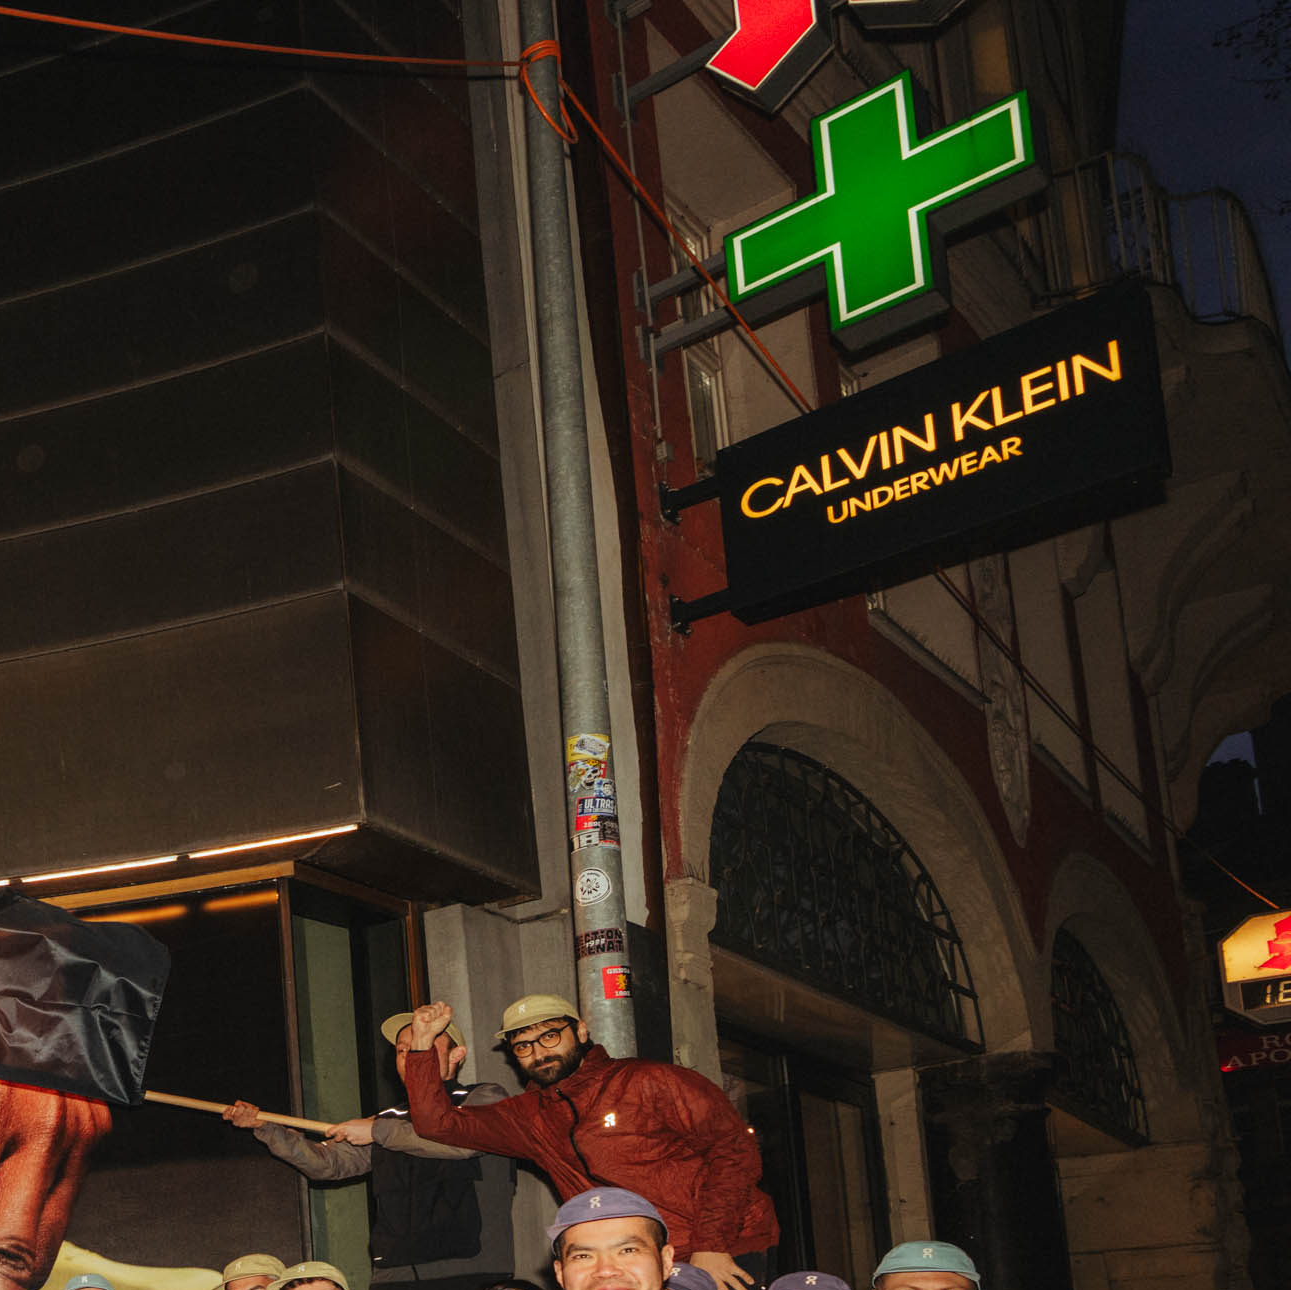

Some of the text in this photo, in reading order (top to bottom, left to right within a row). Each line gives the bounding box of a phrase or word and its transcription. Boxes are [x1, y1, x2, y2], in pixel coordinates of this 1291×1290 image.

[740, 340, 1122, 518] CALVIN KLEIN
[827, 436, 1023, 524] UNDERWEAR
